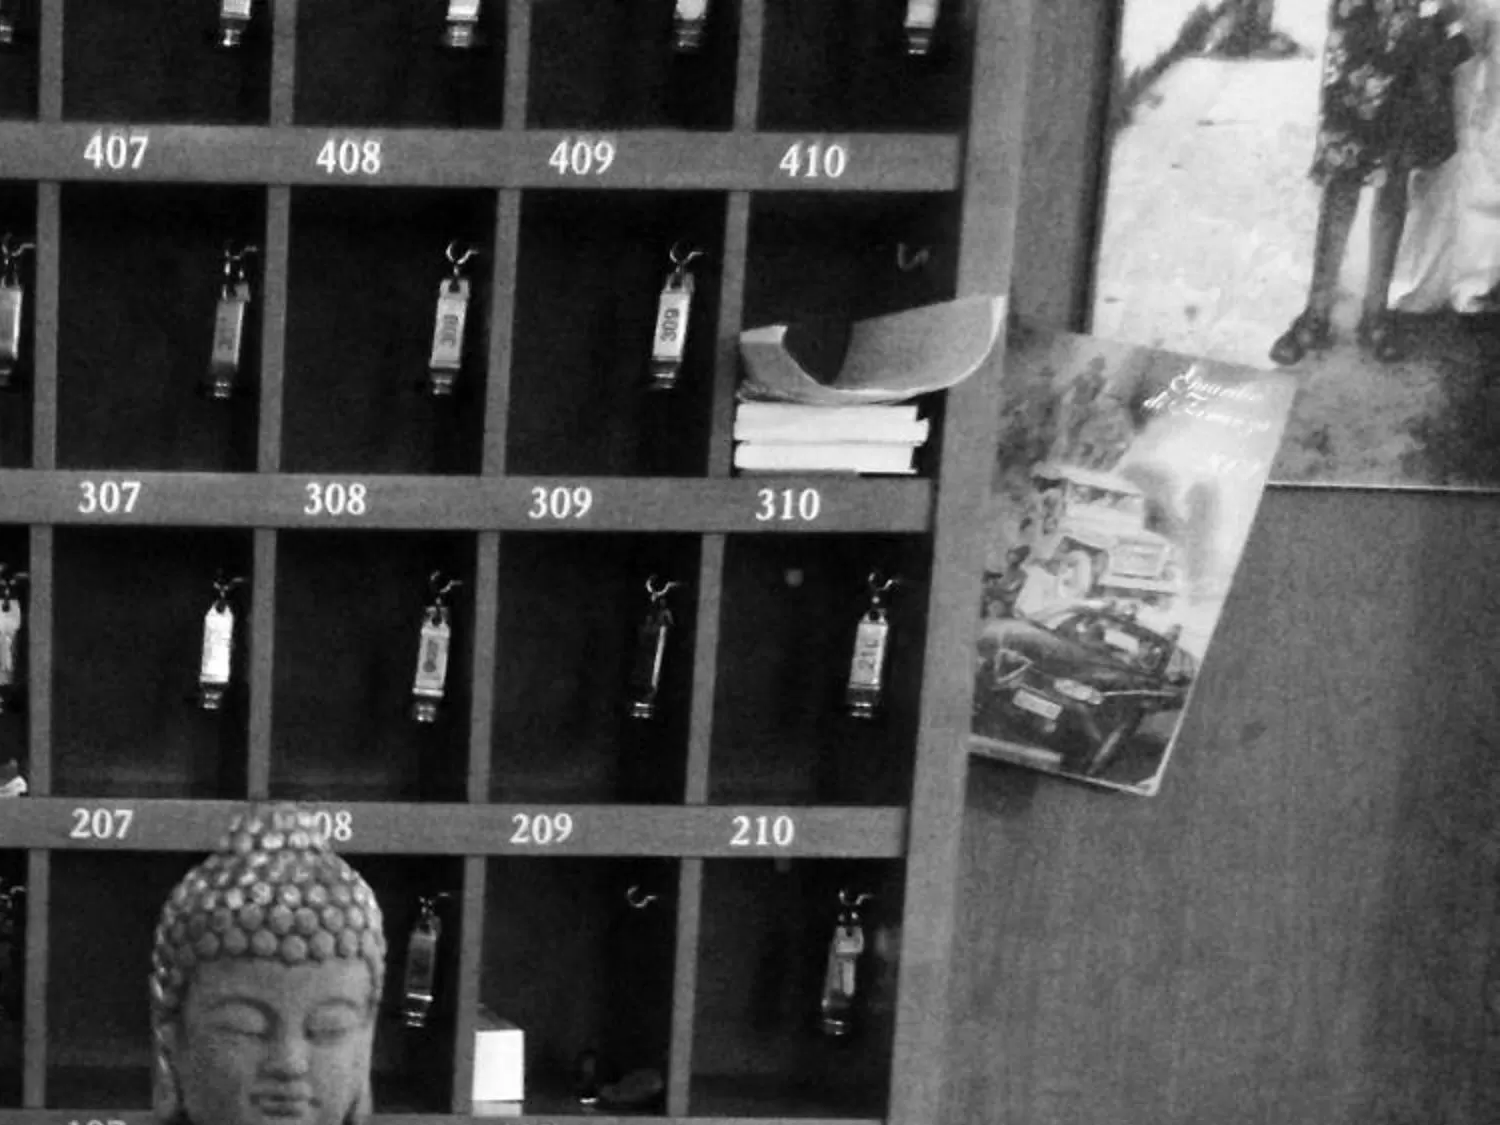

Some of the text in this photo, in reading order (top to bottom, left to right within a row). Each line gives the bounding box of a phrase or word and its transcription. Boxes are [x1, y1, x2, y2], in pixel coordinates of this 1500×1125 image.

[83, 133, 149, 169] 407
[316, 139, 381, 174] 408
[549, 140, 615, 175] 409
[779, 144, 846, 178] 410
[660, 307, 679, 342] 309
[79, 480, 141, 513] 307
[304, 482, 366, 515] 308
[529, 486, 593, 519] 309
[755, 488, 821, 521] 310
[71, 808, 133, 839] 207
[306, 810, 353, 842] 08
[510, 813, 573, 845] 209
[730, 815, 794, 846] 210
